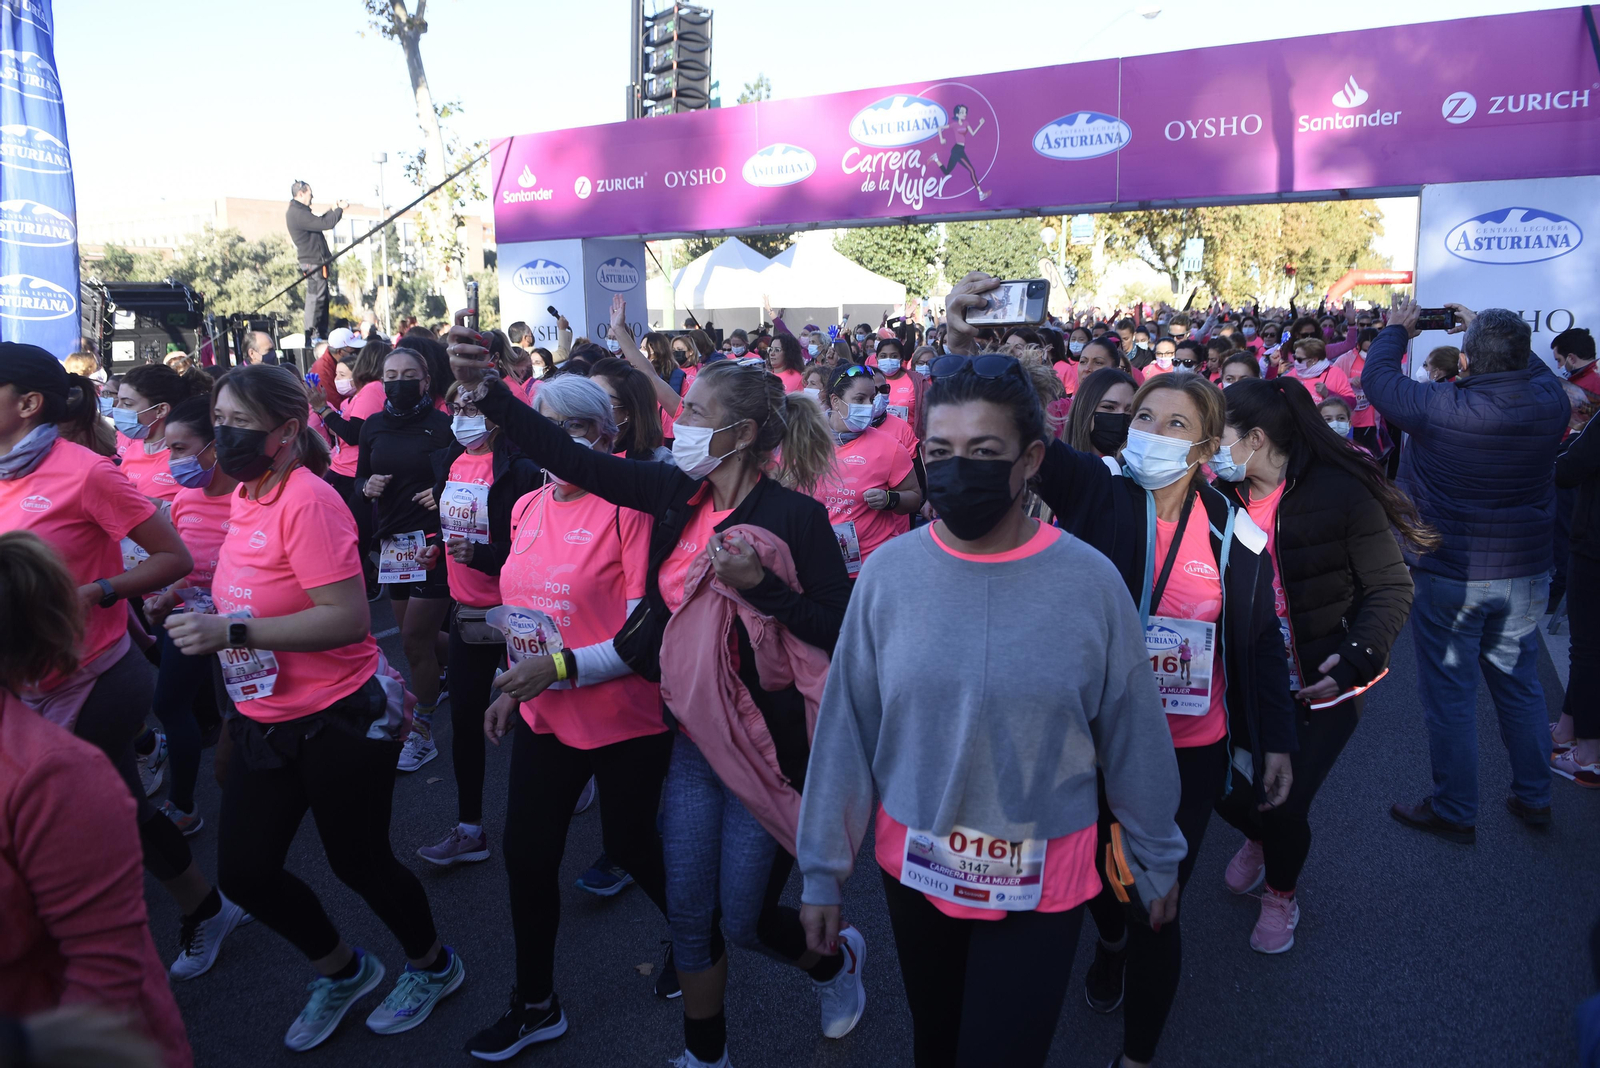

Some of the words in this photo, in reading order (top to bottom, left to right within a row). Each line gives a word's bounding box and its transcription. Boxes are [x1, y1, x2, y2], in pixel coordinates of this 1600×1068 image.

[1488, 90, 1590, 114] ZURICH
[858, 116, 939, 136] ASTURIANA
[1164, 114, 1263, 141] OYSHO
[1298, 109, 1402, 133] Santander
[1041, 132, 1123, 150] ASTURIANA
[0, 143, 70, 169] STURIANA
[841, 147, 921, 175] Carrera
[596, 176, 644, 192] ZURICH
[664, 167, 726, 188] OYSHO
[503, 188, 553, 204] Santander
[861, 174, 876, 192] de
[879, 172, 890, 191] la
[887, 164, 953, 210] Mujer
[0, 219, 71, 241] STURIANA
[1476, 226, 1519, 234] CENTRAL
[1454, 230, 1572, 251] ASTURIANA
[519, 273, 566, 286] ASTURIANA
[600, 271, 637, 284] ASTURIANA
[0, 294, 70, 313] STURIANA
[826, 496, 854, 506] TODAS
[836, 488, 856, 497] POR
[449, 506, 469, 519] 016
[677, 539, 697, 553] SHO
[396, 552, 414, 561] 016
[228, 585, 252, 600] POR
[545, 581, 570, 595] POR
[531, 595, 570, 610] TODAS
[513, 636, 539, 654] 016
[1145, 637, 1178, 645] TURIANA
[226, 648, 249, 664] 016
[1150, 655, 1178, 673] 16
[949, 831, 1007, 859] 016
[929, 862, 964, 880] CARRERA
[967, 873, 979, 882] DE
[980, 875, 990, 884] LA
[992, 877, 1021, 885] MUJER
[960, 860, 990, 874] 3147
[908, 869, 949, 892] OYSHO
